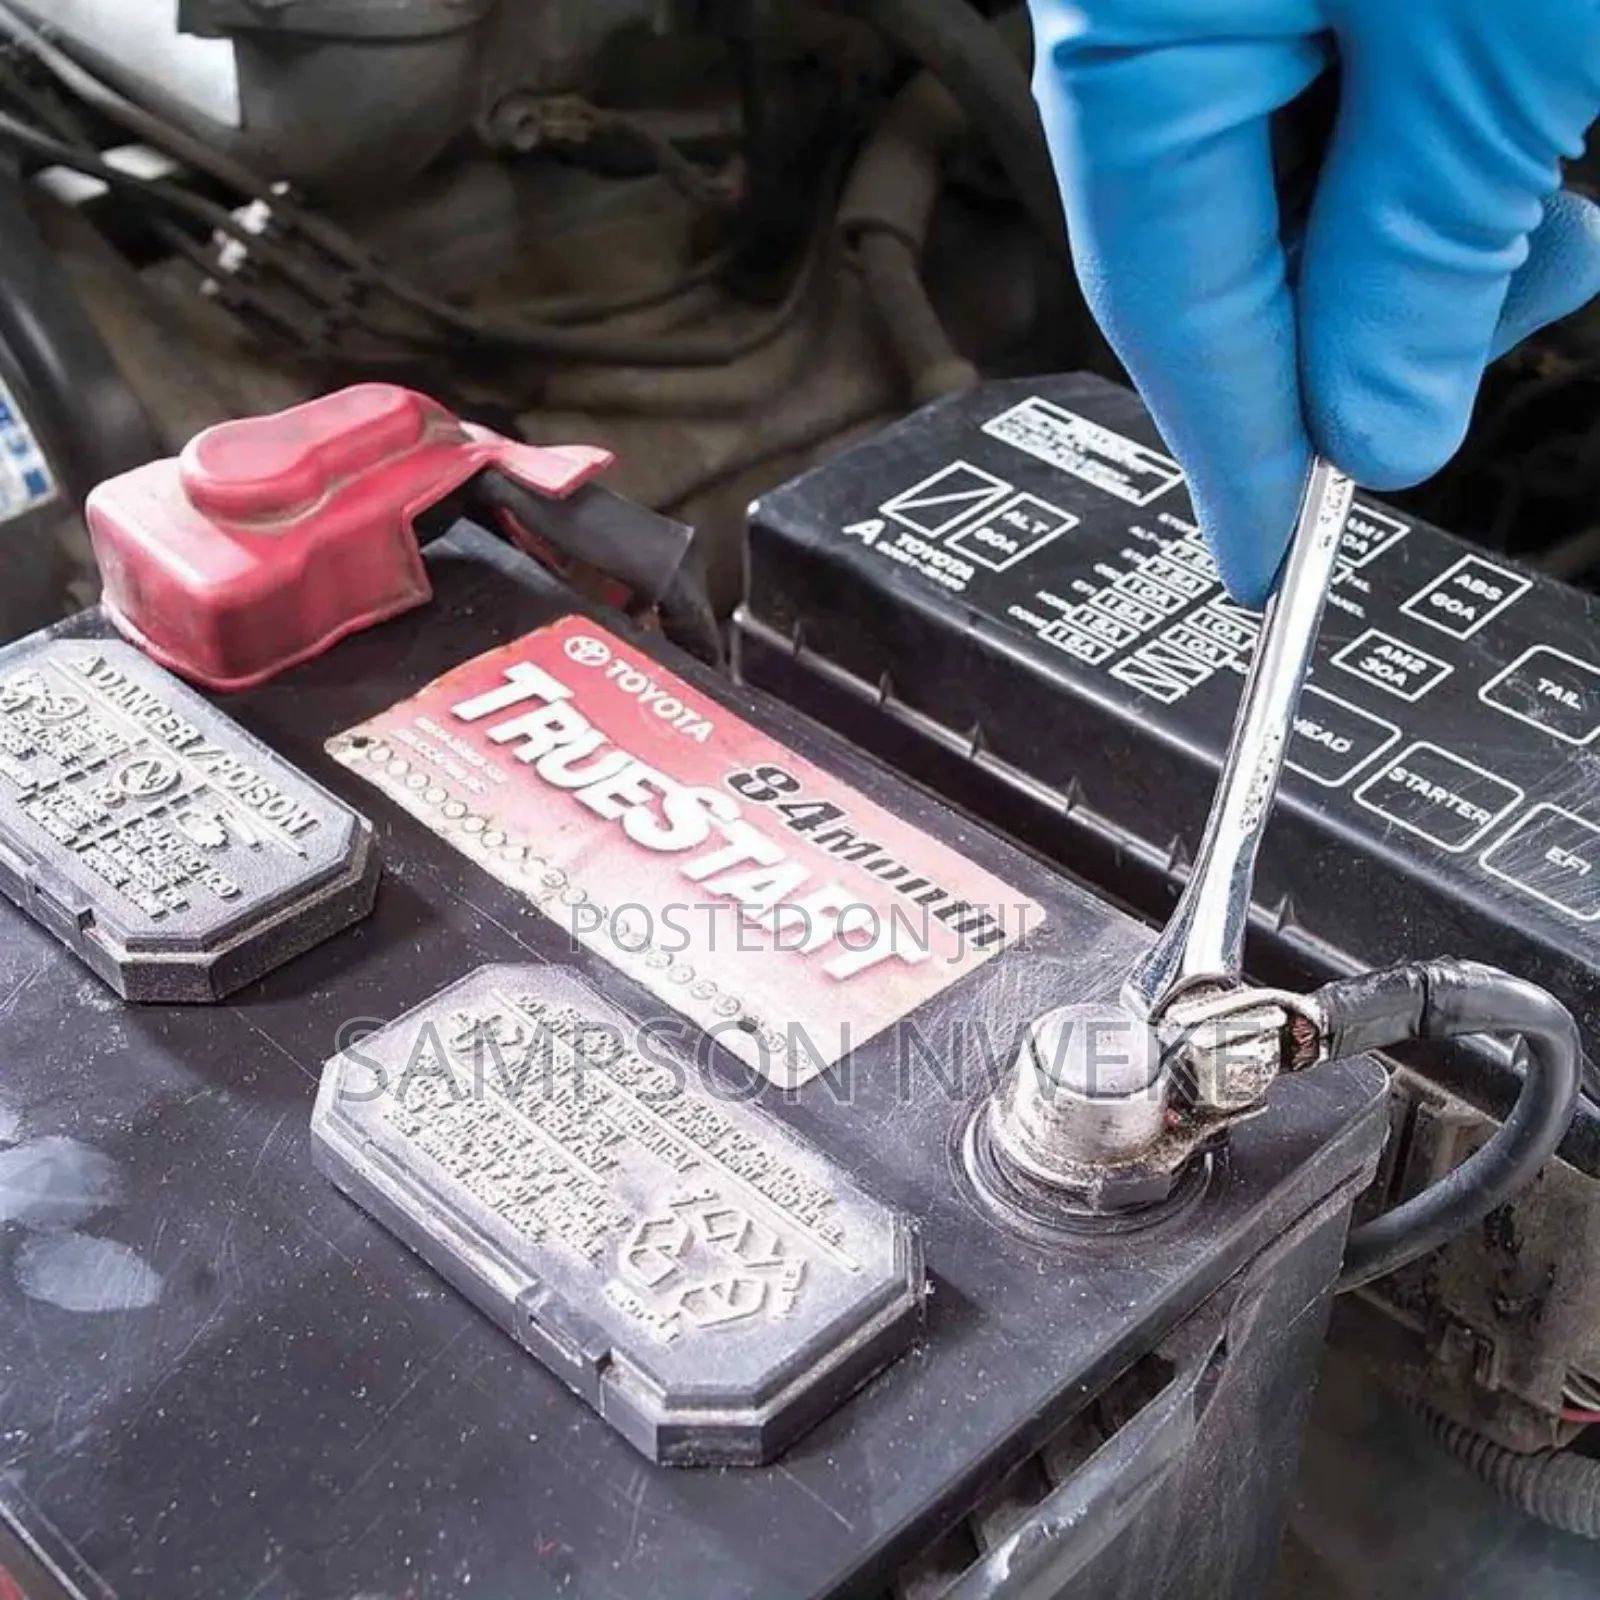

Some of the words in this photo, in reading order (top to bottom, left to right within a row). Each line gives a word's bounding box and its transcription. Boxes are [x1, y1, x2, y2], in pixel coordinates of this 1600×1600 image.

[1002, 509, 1050, 535] ALT
[895, 532, 976, 582] TOYOTA
[1128, 577, 1174, 607] 10A
[1452, 572, 1504, 602] ABS
[1201, 612, 1245, 645] 10A
[1177, 630, 1220, 661] 10A
[1372, 642, 1428, 675] AM2
[1358, 657, 1410, 688] 30A
[604, 658, 714, 742] TOYOTA
[1536, 677, 1583, 711] TAIL
[1388, 765, 1497, 825] STARTER
[450, 660, 932, 982] TRUESTART
[1545, 845, 1593, 877] EFI
